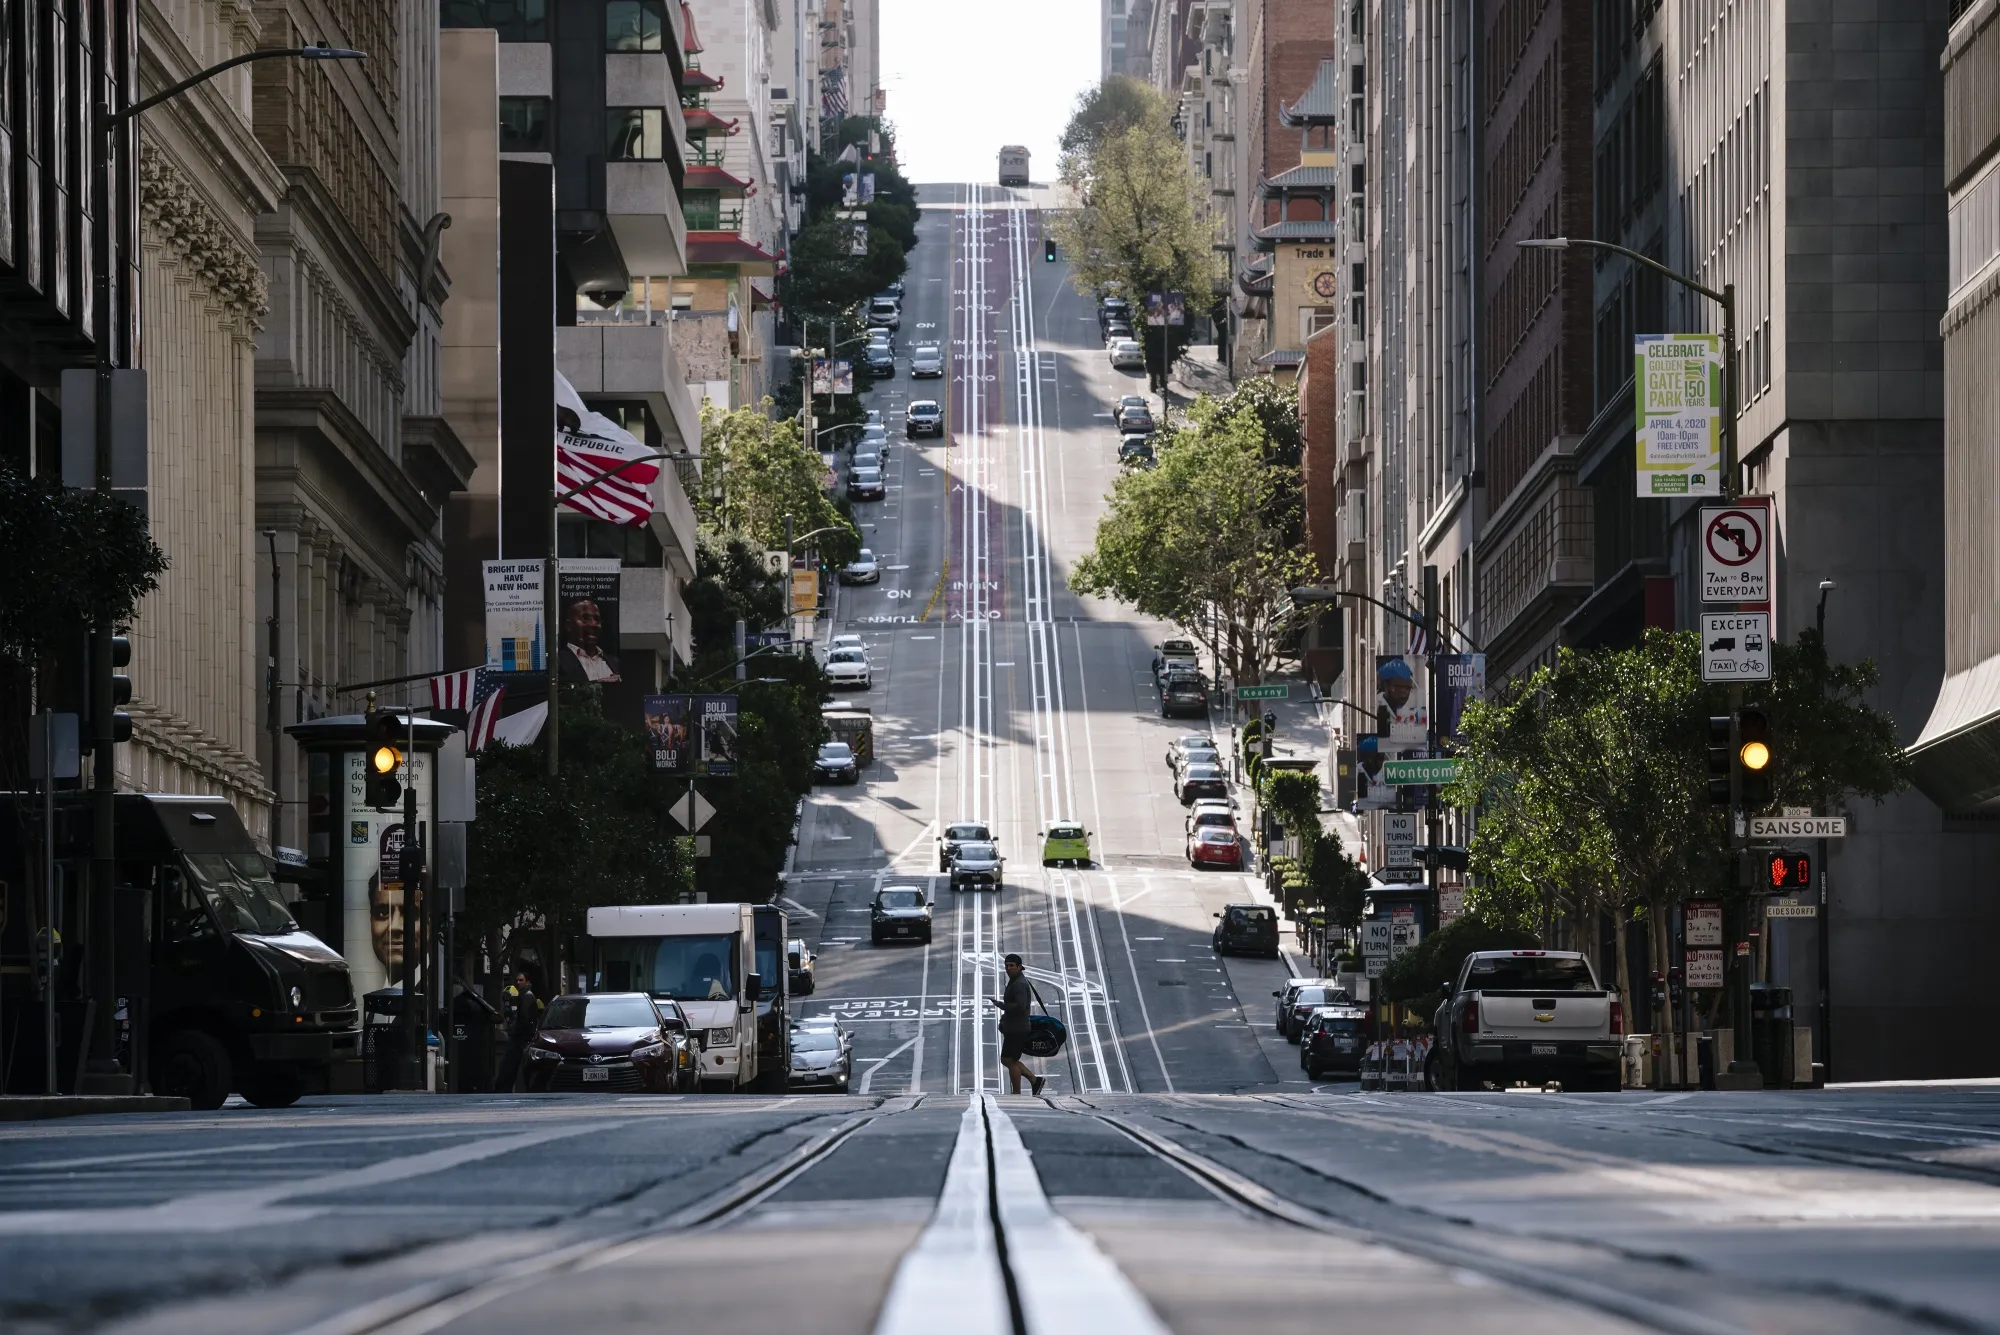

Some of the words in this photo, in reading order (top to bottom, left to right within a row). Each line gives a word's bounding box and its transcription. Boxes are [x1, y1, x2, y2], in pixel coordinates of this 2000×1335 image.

[1296, 248, 1324, 258] Trade
[1649, 344, 1704, 357] CELEBRATE
[1649, 360, 1682, 371] GOLDEN
[1649, 373, 1682, 389] GATE
[1685, 380, 1705, 397] 150
[1650, 391, 1682, 407] PARK
[1685, 398, 1704, 406] YEARS
[1650, 420, 1674, 429] APRIL
[1676, 420, 1682, 429] 4,
[1685, 419, 1706, 429] 2020
[1658, 431, 1698, 441] 10am-10pm
[564, 436, 624, 454] REPUBLIC
[1658, 442, 1673, 450] FREE
[887, 590, 911, 598] NO
[1707, 586, 1763, 595] EVERYDAY
[1712, 620, 1758, 630] EXCEPT
[1448, 664, 1472, 676] BOLD
[1448, 677, 1472, 686] LIVING
[706, 702, 726, 712] BOLD
[656, 750, 677, 760] BOLD
[656, 760, 676, 768] WORKS
[396, 773, 418, 783] appen
[1386, 767, 1462, 781] Montgome
[352, 784, 362, 795] by
[1393, 820, 1406, 828] NO
[1754, 822, 1842, 834] SANSOME
[1799, 860, 1807, 882] 0
[1687, 910, 1697, 919] NO
[1372, 927, 1387, 937] NO
[1364, 942, 1388, 950] TURN
[1686, 951, 1697, 961] NO
[1699, 953, 1722, 961] PARKING
[829, 1001, 909, 1010] KEEP
